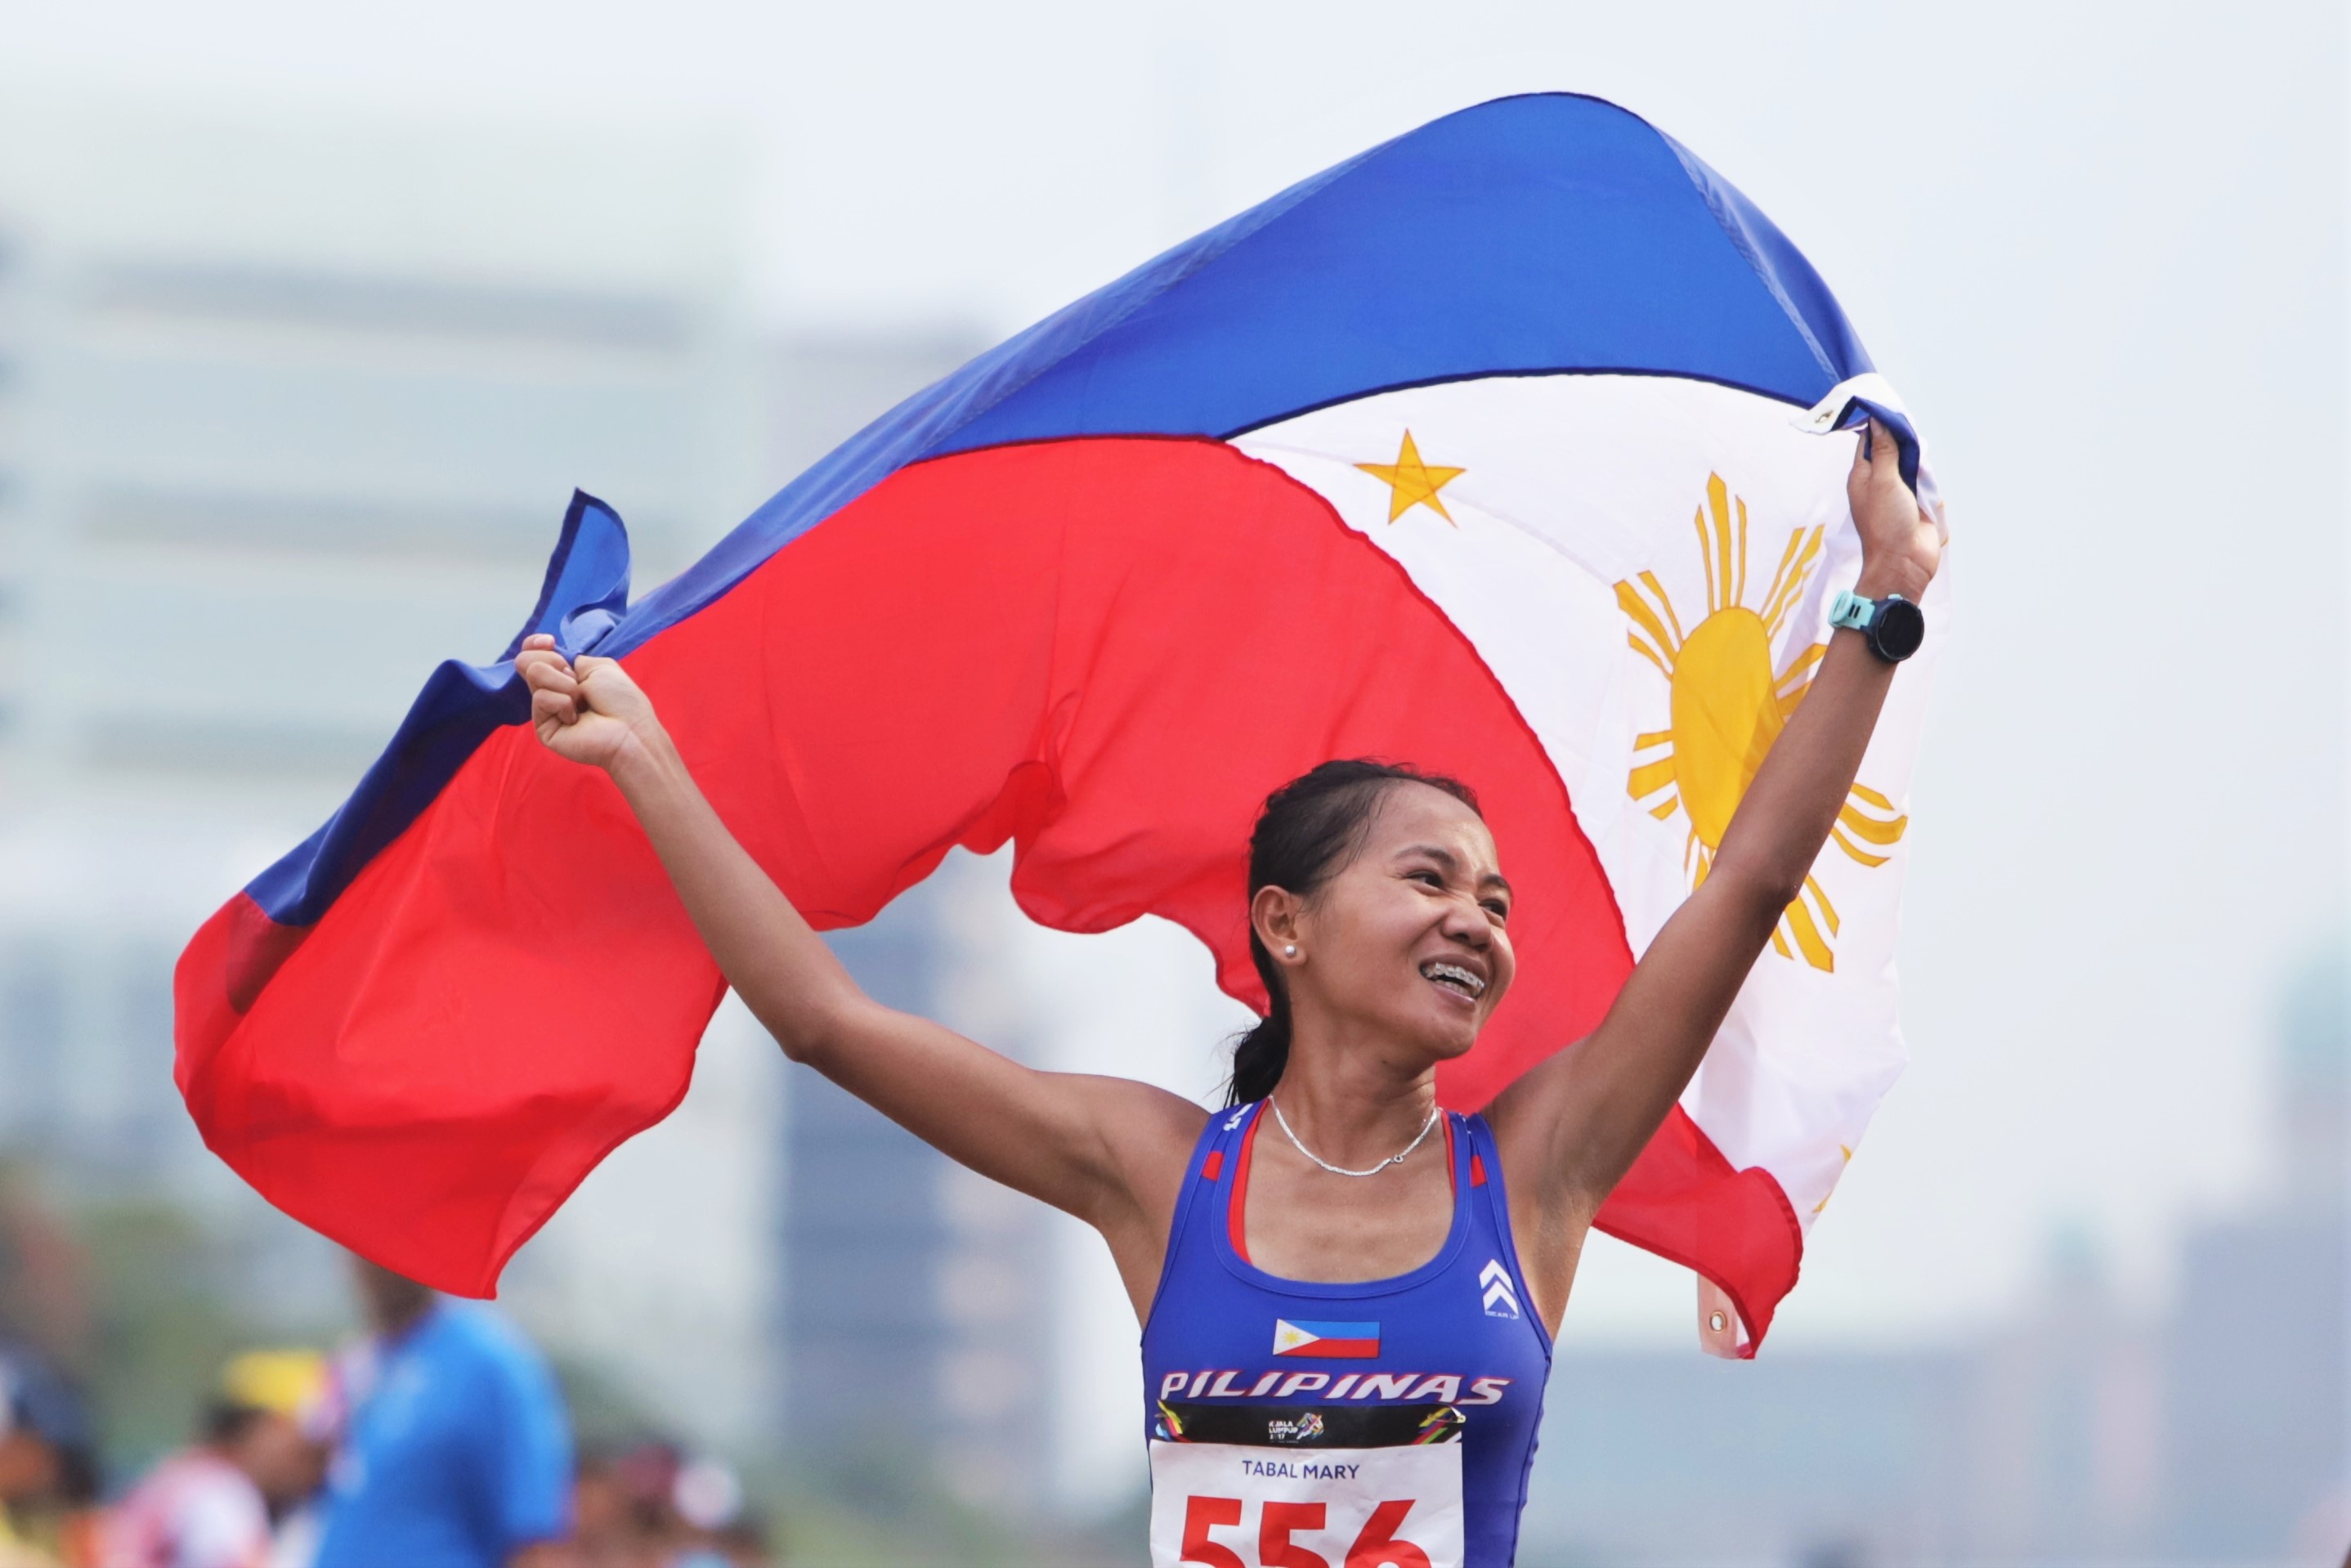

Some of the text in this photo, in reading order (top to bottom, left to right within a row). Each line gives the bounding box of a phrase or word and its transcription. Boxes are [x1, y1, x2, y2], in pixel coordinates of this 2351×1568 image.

[1160, 1370, 1515, 1405] PILIPINAS
[1242, 1460, 1359, 1479] TABAL MARY
[1180, 1495, 1432, 1568] 556
